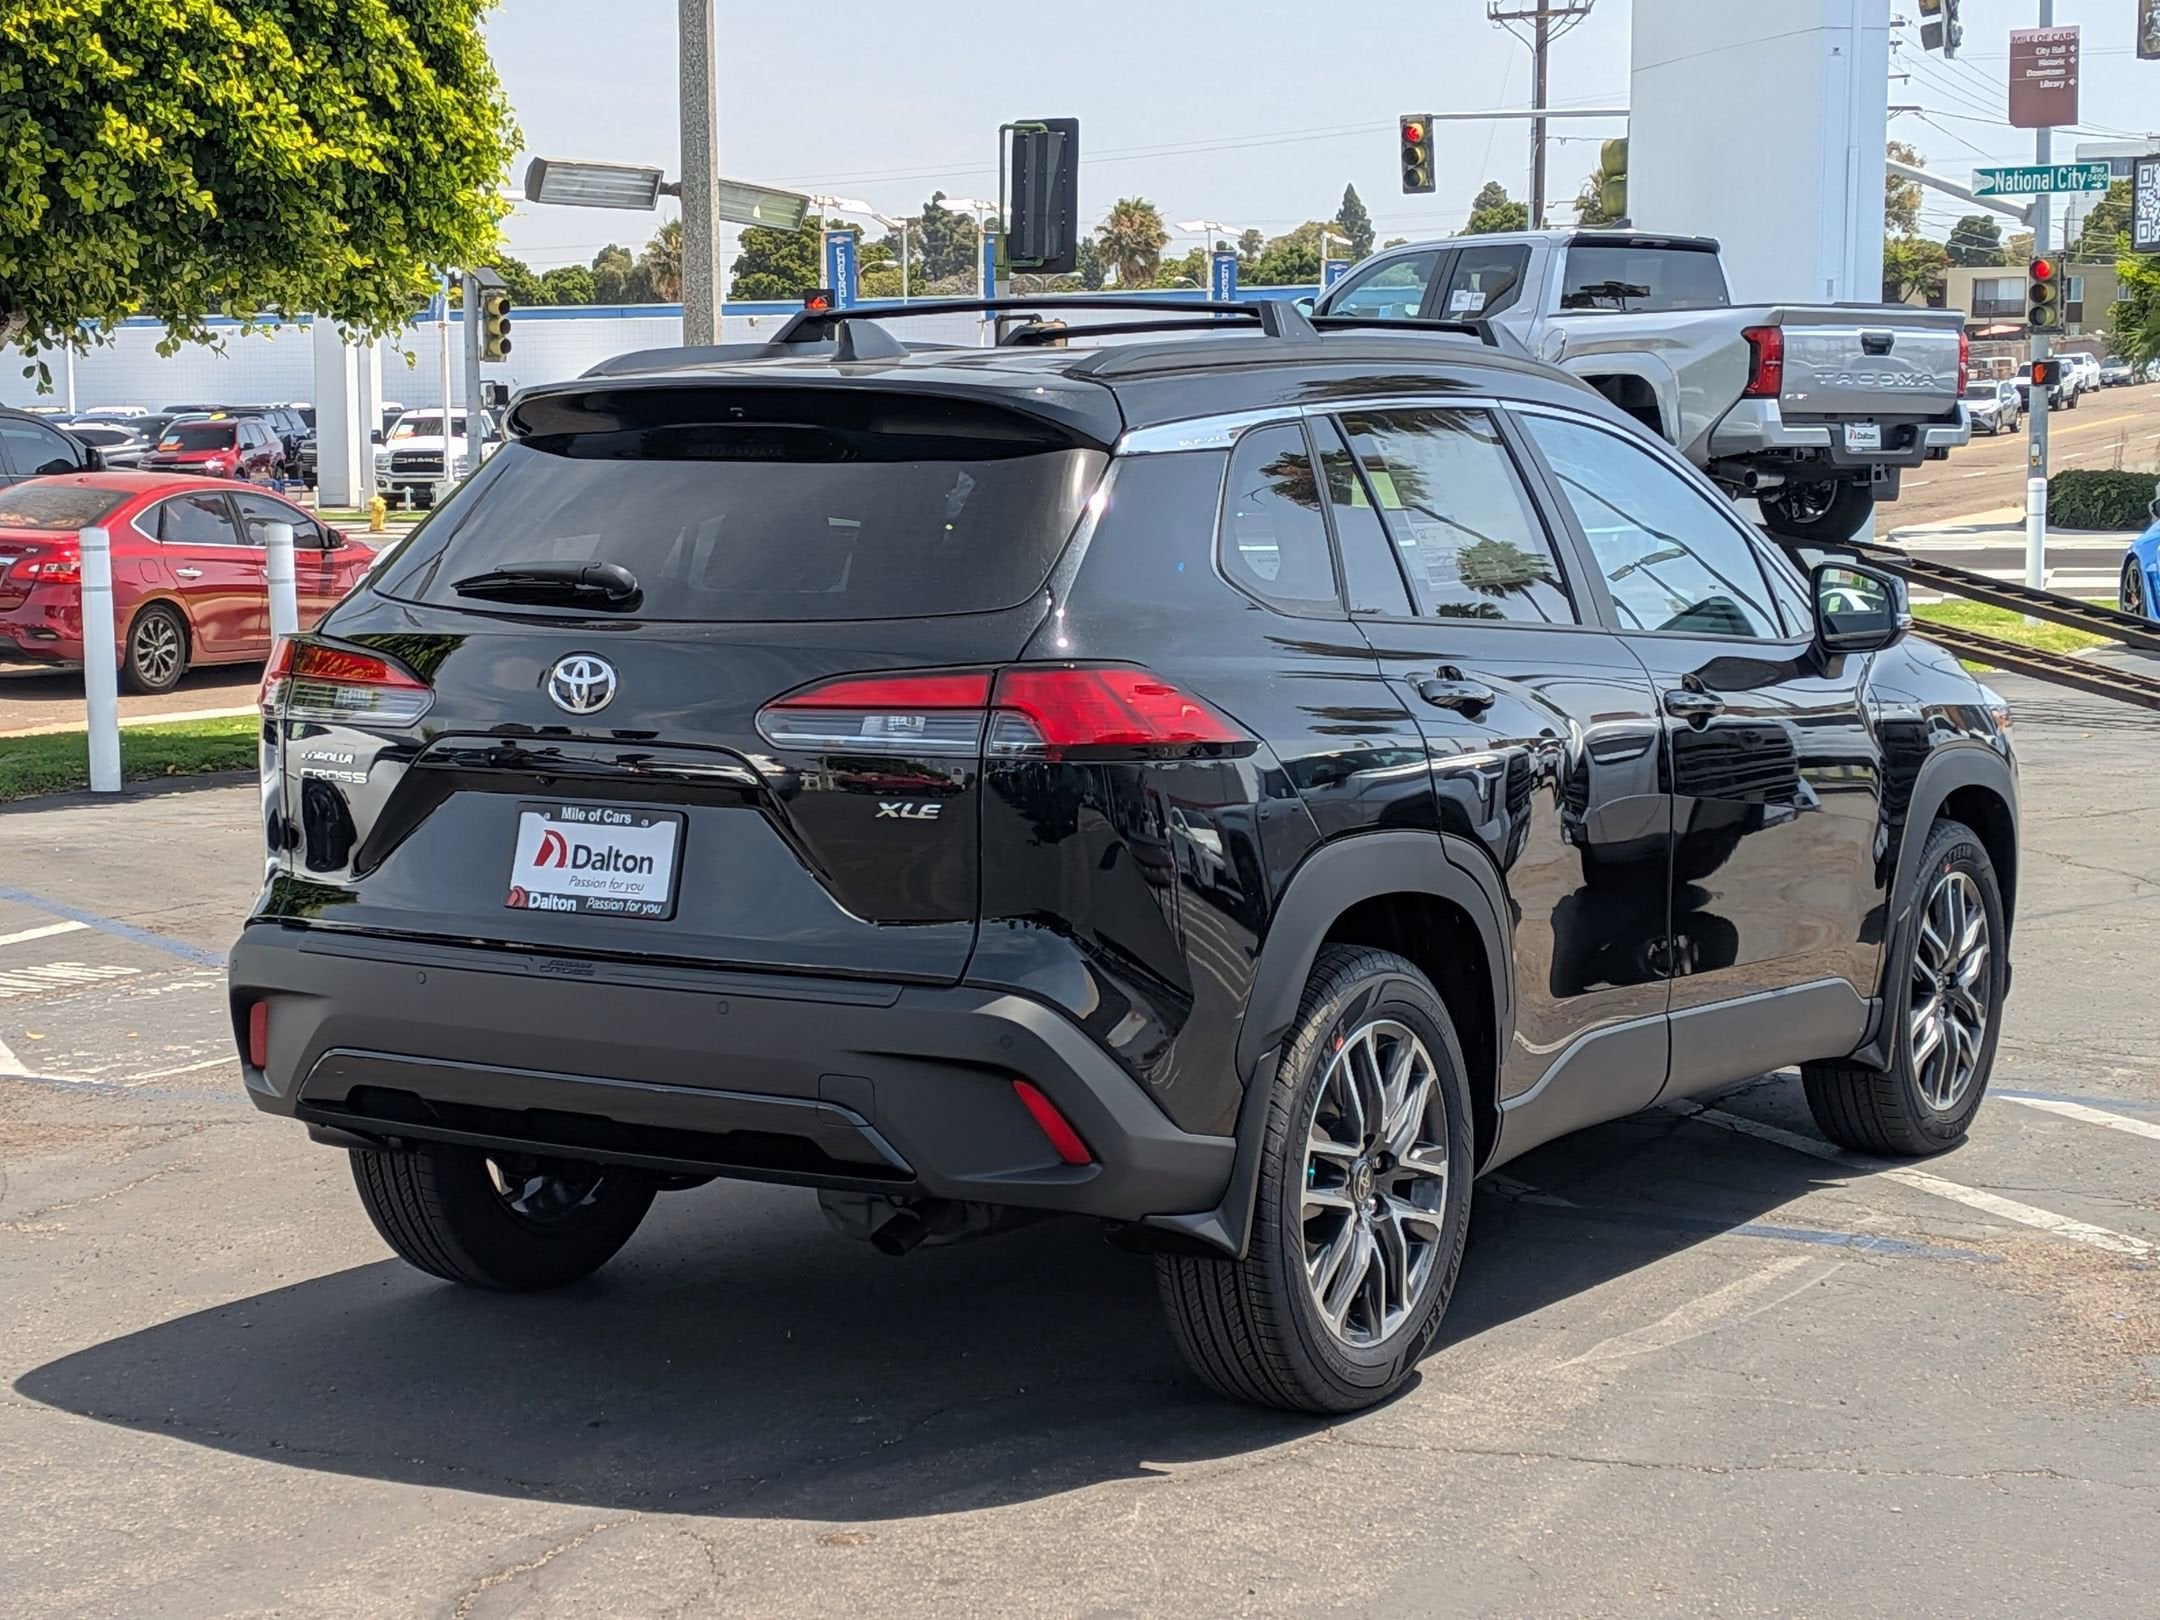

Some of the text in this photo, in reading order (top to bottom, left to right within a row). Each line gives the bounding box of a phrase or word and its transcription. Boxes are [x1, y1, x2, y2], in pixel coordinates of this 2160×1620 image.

[2052, 31, 2077, 41] CARS
[2035, 46, 2050, 56] City
[2040, 80, 2065, 89] Library
[1995, 167, 2087, 192] National City
[2087, 173, 2108, 182] 2400
[835, 246, 847, 311] CHEVROLE
[1814, 372, 1935, 386] TACOMA
[301, 767, 368, 785] CROSS
[561, 806, 632, 825] Mile of Cars
[875, 801, 943, 820] XLE
[571, 844, 654, 874] Dalton
[568, 875, 645, 893] Passion for you
[528, 891, 663, 915] Dalton Passion for you
